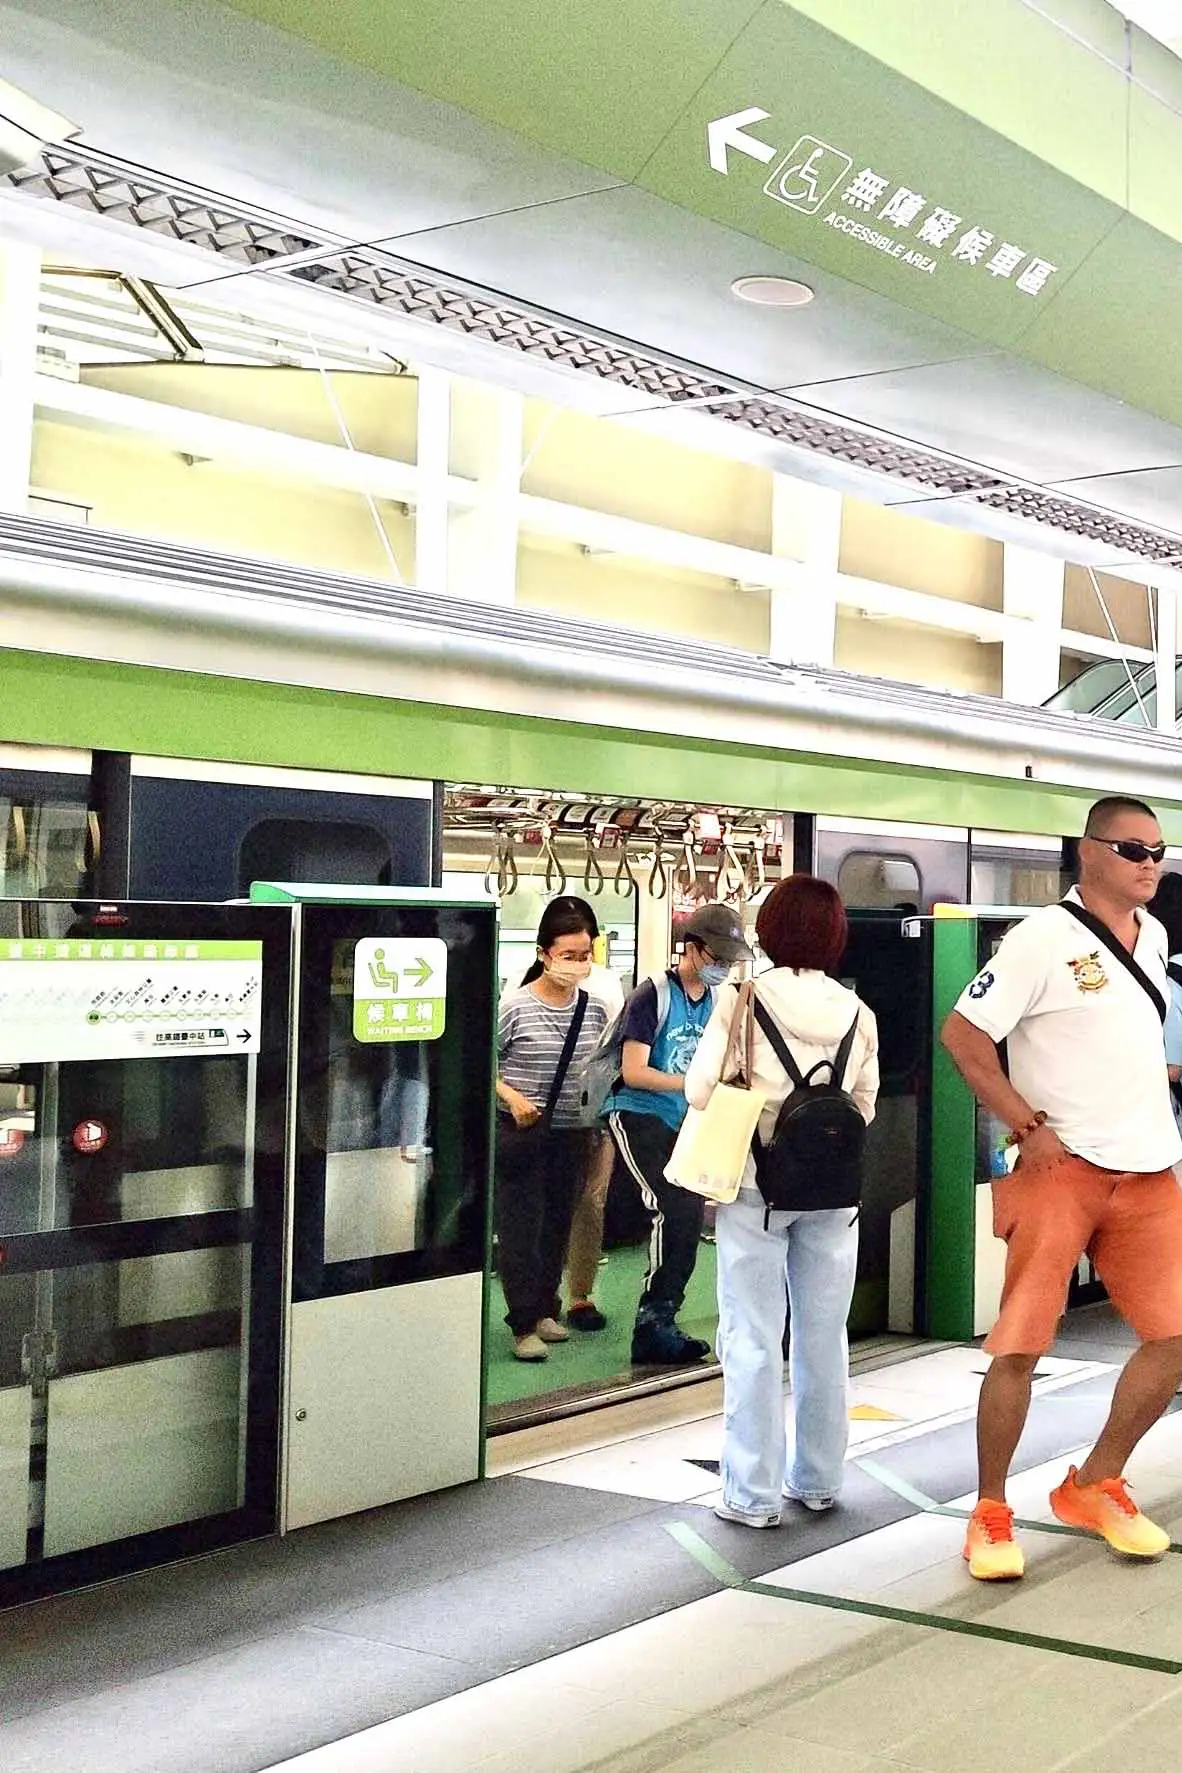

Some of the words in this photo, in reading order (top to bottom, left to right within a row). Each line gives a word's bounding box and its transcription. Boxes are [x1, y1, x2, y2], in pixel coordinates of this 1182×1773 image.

[823, 211, 902, 258] ACCESSIBLE
[900, 250, 936, 274] AREA
[841, 168, 1059, 296] 無障礙候車區
